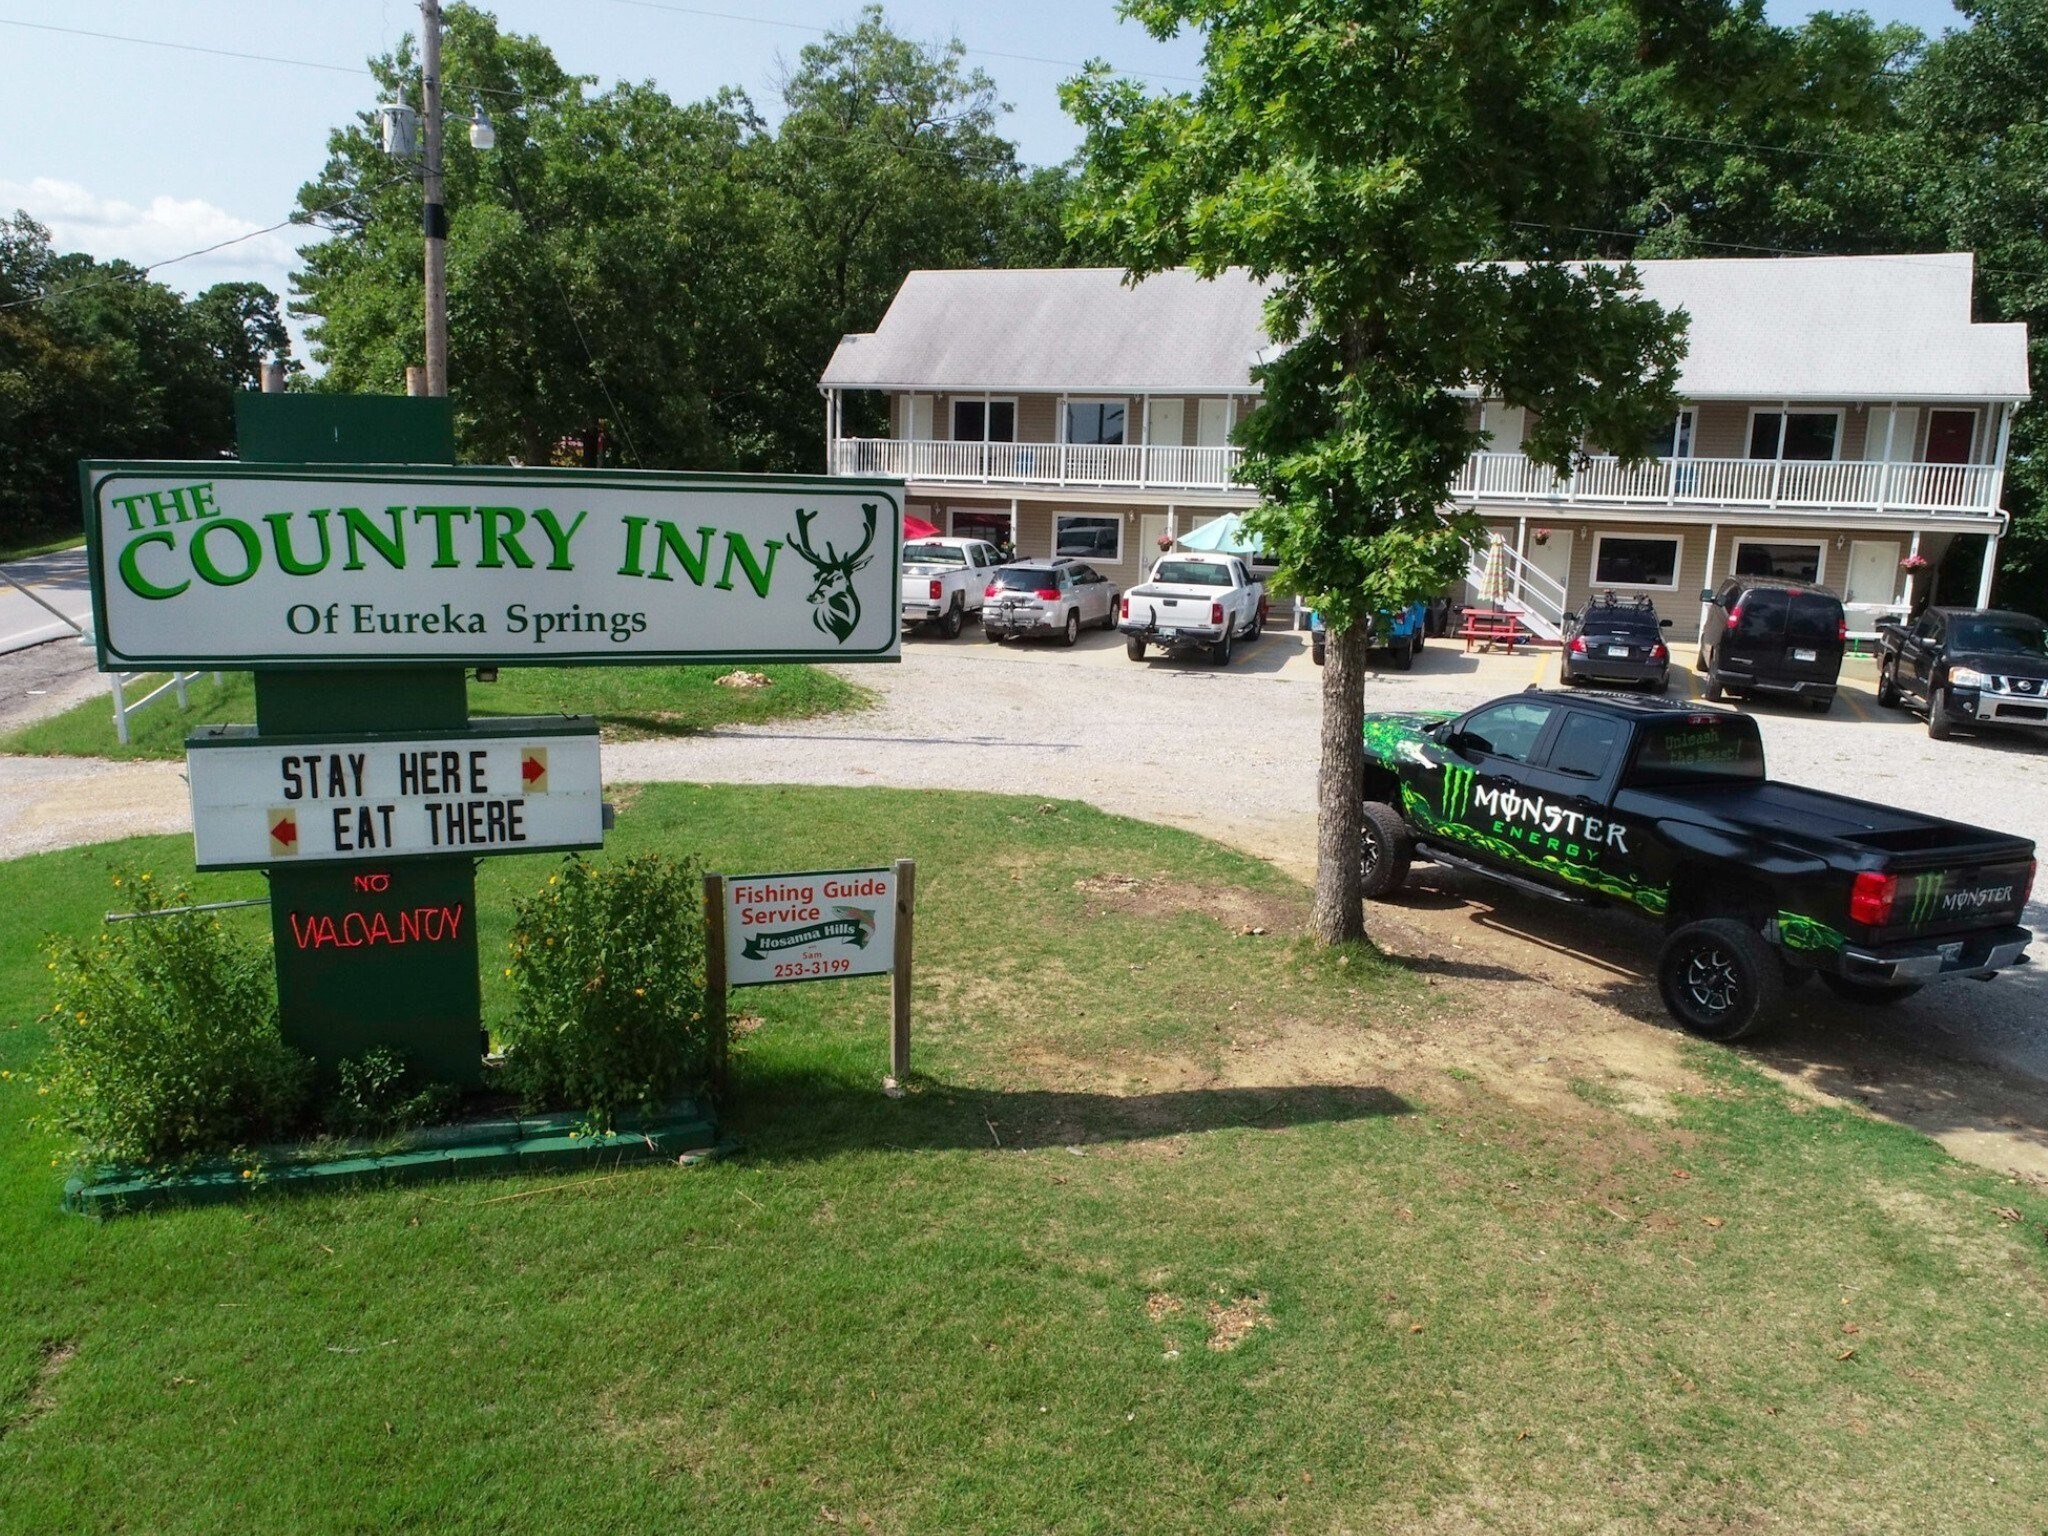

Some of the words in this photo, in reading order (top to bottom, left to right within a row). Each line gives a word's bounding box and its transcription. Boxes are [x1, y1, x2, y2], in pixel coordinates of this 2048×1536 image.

[112, 481, 223, 531] THE
[117, 505, 590, 601] COUNTRY
[617, 514, 786, 598] INN
[287, 604, 341, 635] Of
[354, 604, 487, 635] Eureka
[506, 604, 649, 644] Springs
[281, 753, 366, 800] STAY
[400, 750, 488, 795] HERE
[333, 805, 396, 851] EAT
[425, 799, 526, 846] THERE
[1473, 784, 1629, 854] MONSTER
[1493, 820, 1599, 862] ENERGY
[354, 874, 391, 893] NO
[734, 884, 814, 905] Fishing
[823, 879, 886, 898] Guide
[1943, 886, 2013, 910] MONSTER
[290, 905, 463, 948] VACANCY
[741, 905, 820, 926] Service
[759, 930, 820, 949] Hosanna
[824, 923, 856, 937] Hills
[802, 951, 822, 960] Sam
[774, 959, 850, 978] 253-3199
